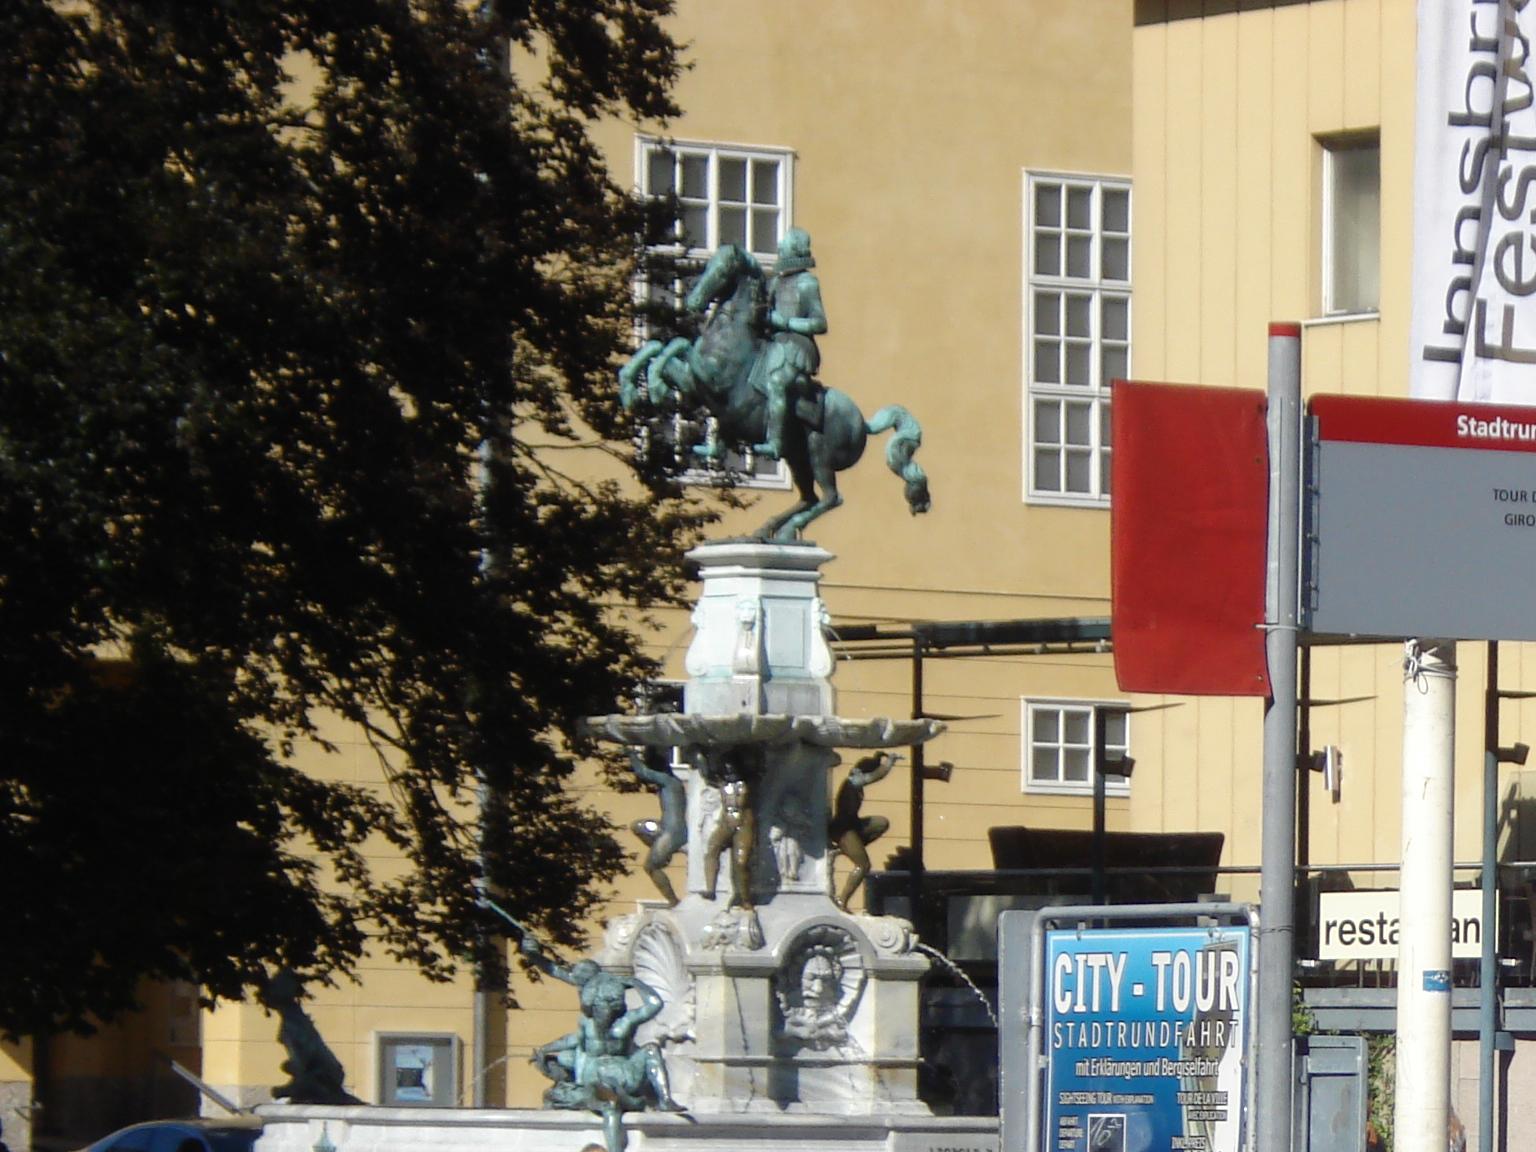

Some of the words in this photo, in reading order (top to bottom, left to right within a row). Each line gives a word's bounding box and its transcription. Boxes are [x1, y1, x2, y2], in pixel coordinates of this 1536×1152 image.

[1423, 0, 1500, 364] Innsbr
[1493, 488, 1528, 503] TOUR
[1504, 513, 1536, 528] GIRO
[1325, 911, 1481, 946] restaan
[1053, 951, 1129, 1014] CITY
[1151, 950, 1240, 1012] TOUR
[1053, 1020, 1239, 1049] STADTRUNDFAHRT
[1075, 1058, 1090, 1076] mit
[1091, 1058, 1141, 1079] Erklärungen
[1143, 1058, 1160, 1076] und
